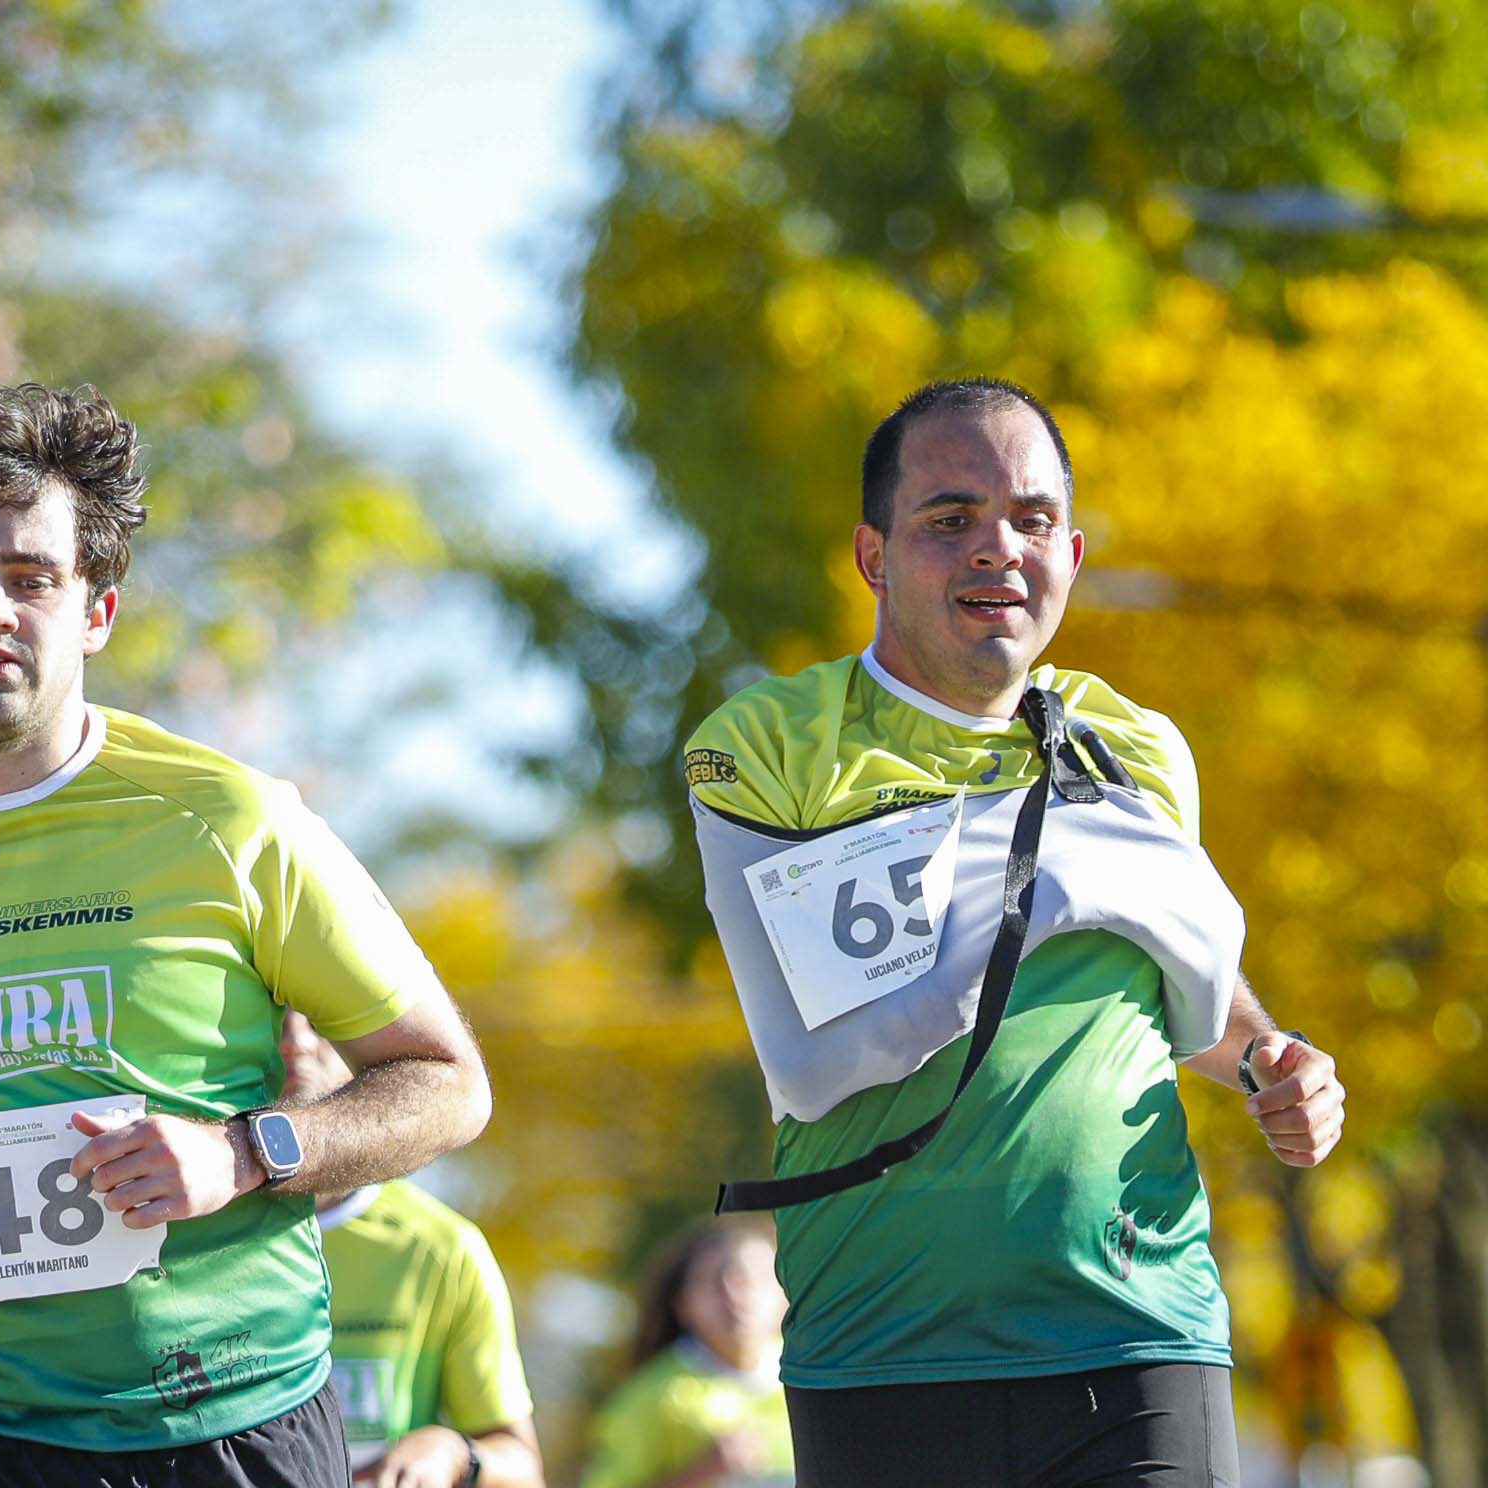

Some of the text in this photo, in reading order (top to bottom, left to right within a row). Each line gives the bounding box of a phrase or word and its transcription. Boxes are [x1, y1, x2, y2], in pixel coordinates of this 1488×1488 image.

[712, 753, 737, 769] DEL
[685, 763, 738, 785] UEBLO
[832, 855, 933, 959] 65
[864, 956, 905, 981] LUCIANO
[37, 1255, 89, 1273] MARITANO
[209, 1330, 253, 1366] 4K
[214, 1354, 272, 1391] 10K
